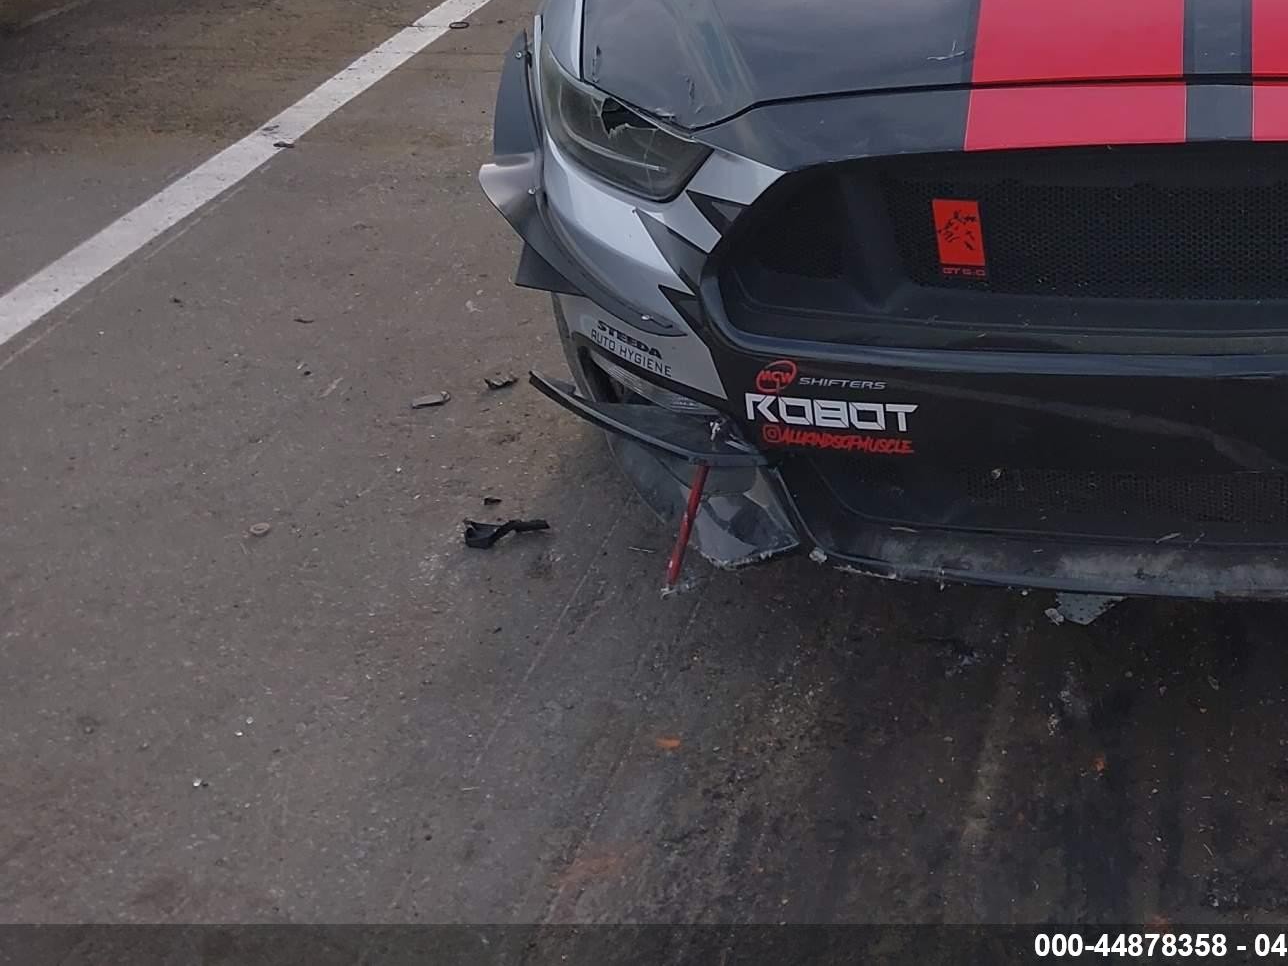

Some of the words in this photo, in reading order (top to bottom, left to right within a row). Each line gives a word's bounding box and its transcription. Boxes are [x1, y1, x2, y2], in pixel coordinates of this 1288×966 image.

[591, 328, 616, 352] AUTO
[620, 345, 672, 378] HYGIENE
[598, 320, 663, 360] STEEDA
[799, 377, 887, 390] SHIFTERS
